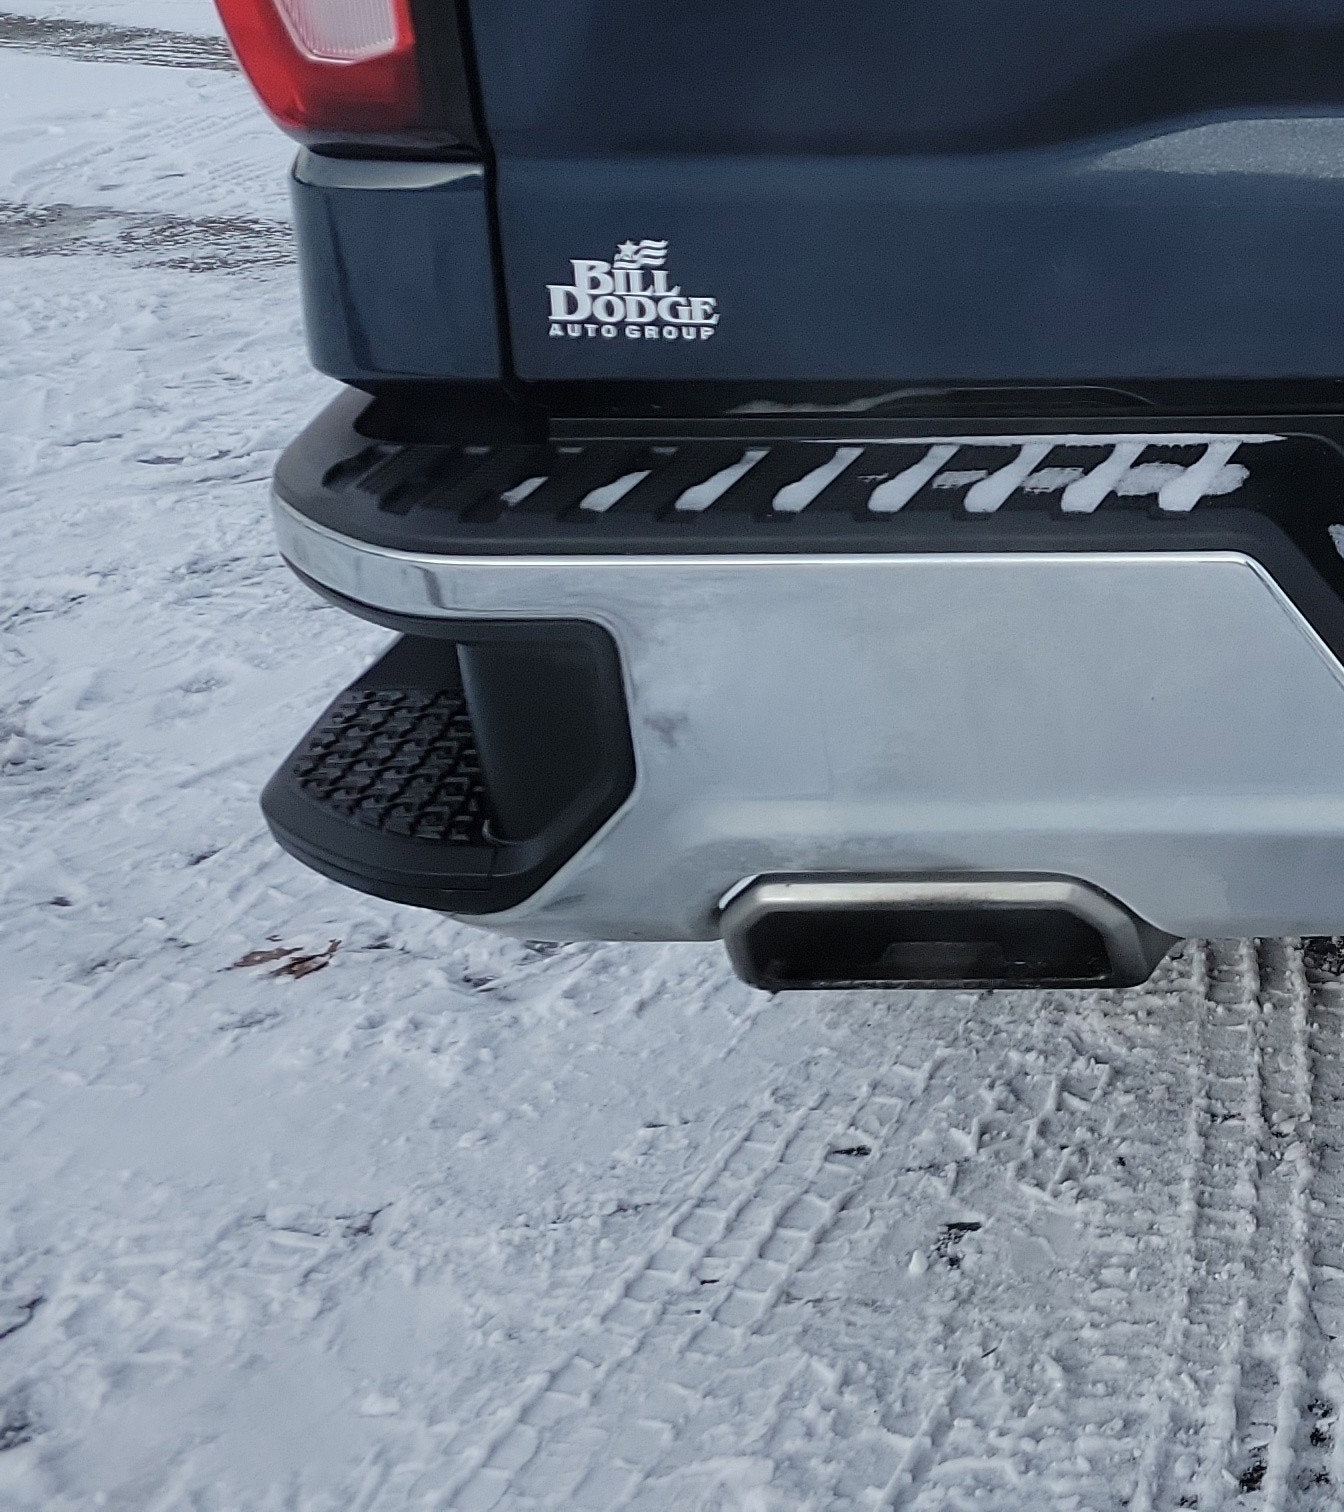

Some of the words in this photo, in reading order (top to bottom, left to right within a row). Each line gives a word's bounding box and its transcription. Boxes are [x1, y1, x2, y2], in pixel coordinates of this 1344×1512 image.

[570, 259, 681, 296] BILL
[546, 284, 721, 325] DODGE
[548, 323, 618, 338] AUTO
[625, 325, 715, 339] GROUP
